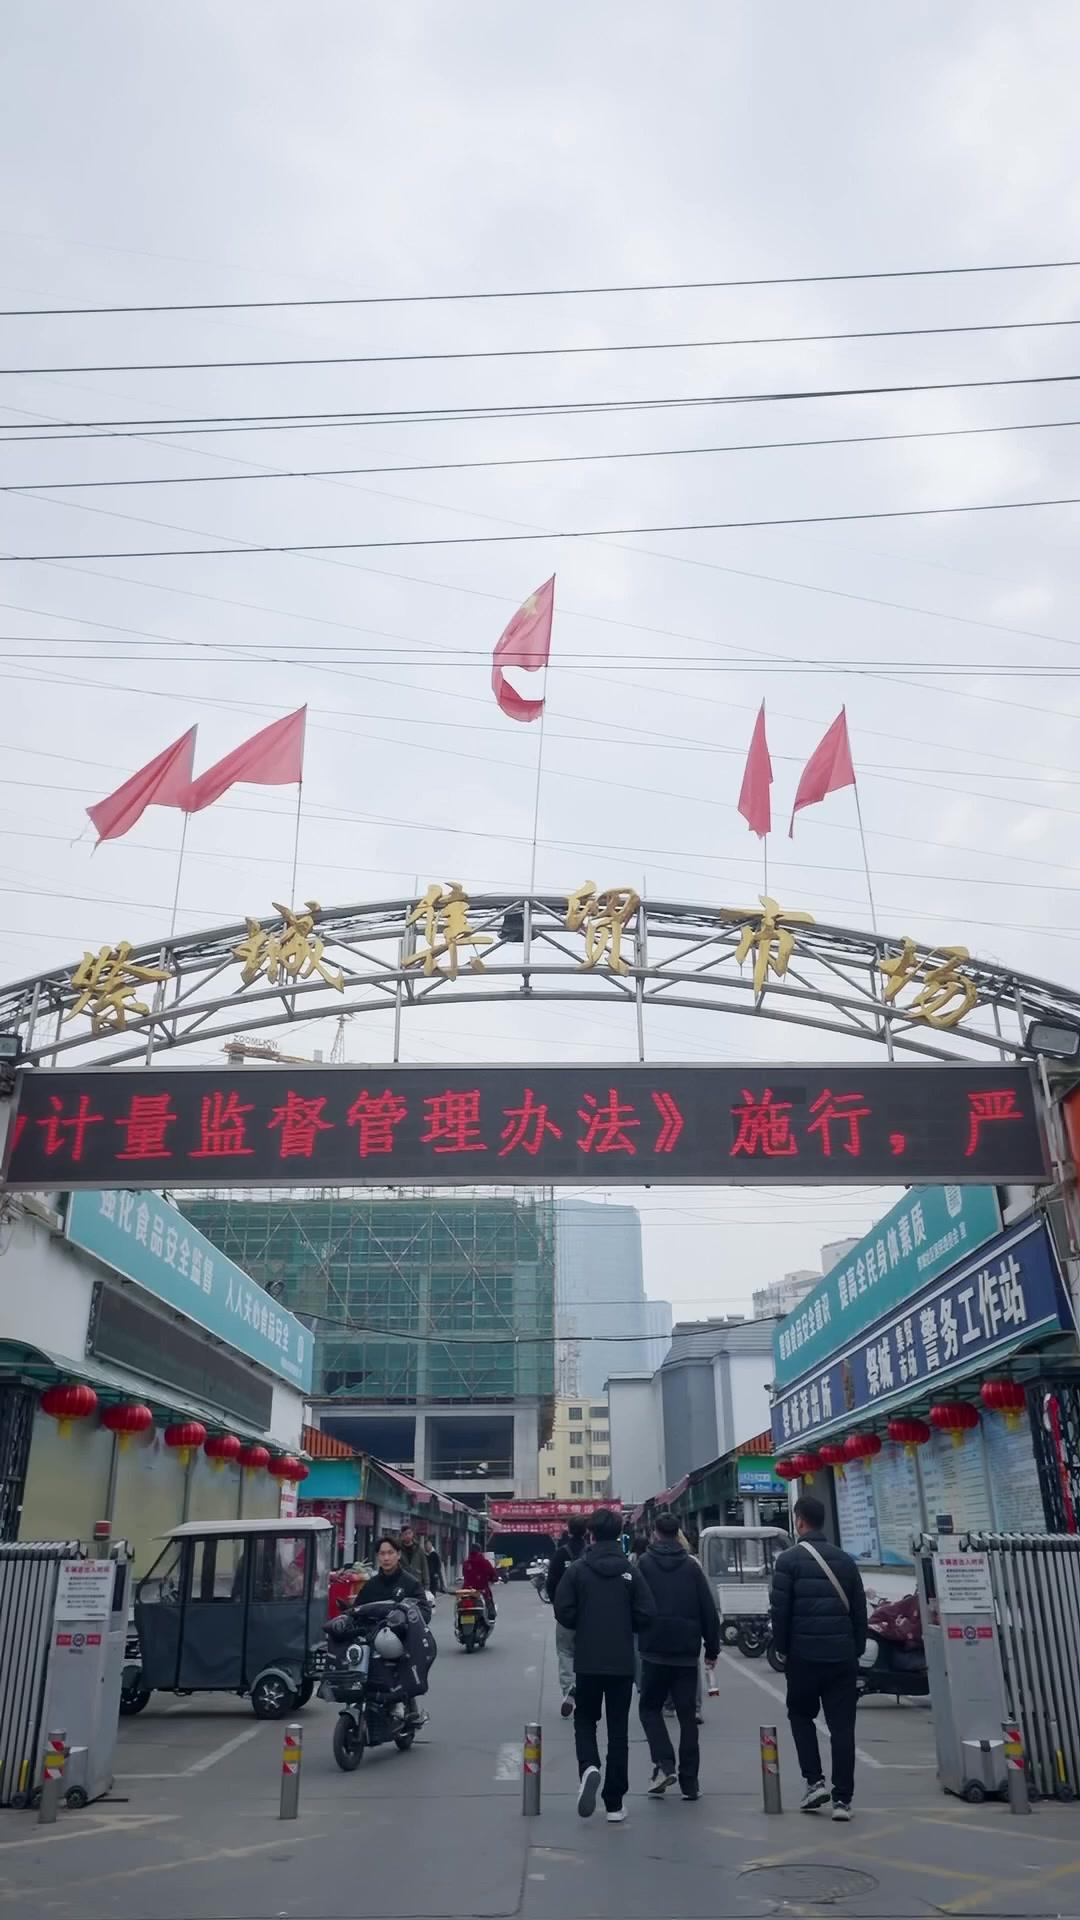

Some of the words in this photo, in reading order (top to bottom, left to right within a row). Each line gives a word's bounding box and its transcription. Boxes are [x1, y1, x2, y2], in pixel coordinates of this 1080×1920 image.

[838, 1201, 927, 1311] 提高全民身体素质
[920, 1254, 1028, 1371] 警务工作站
